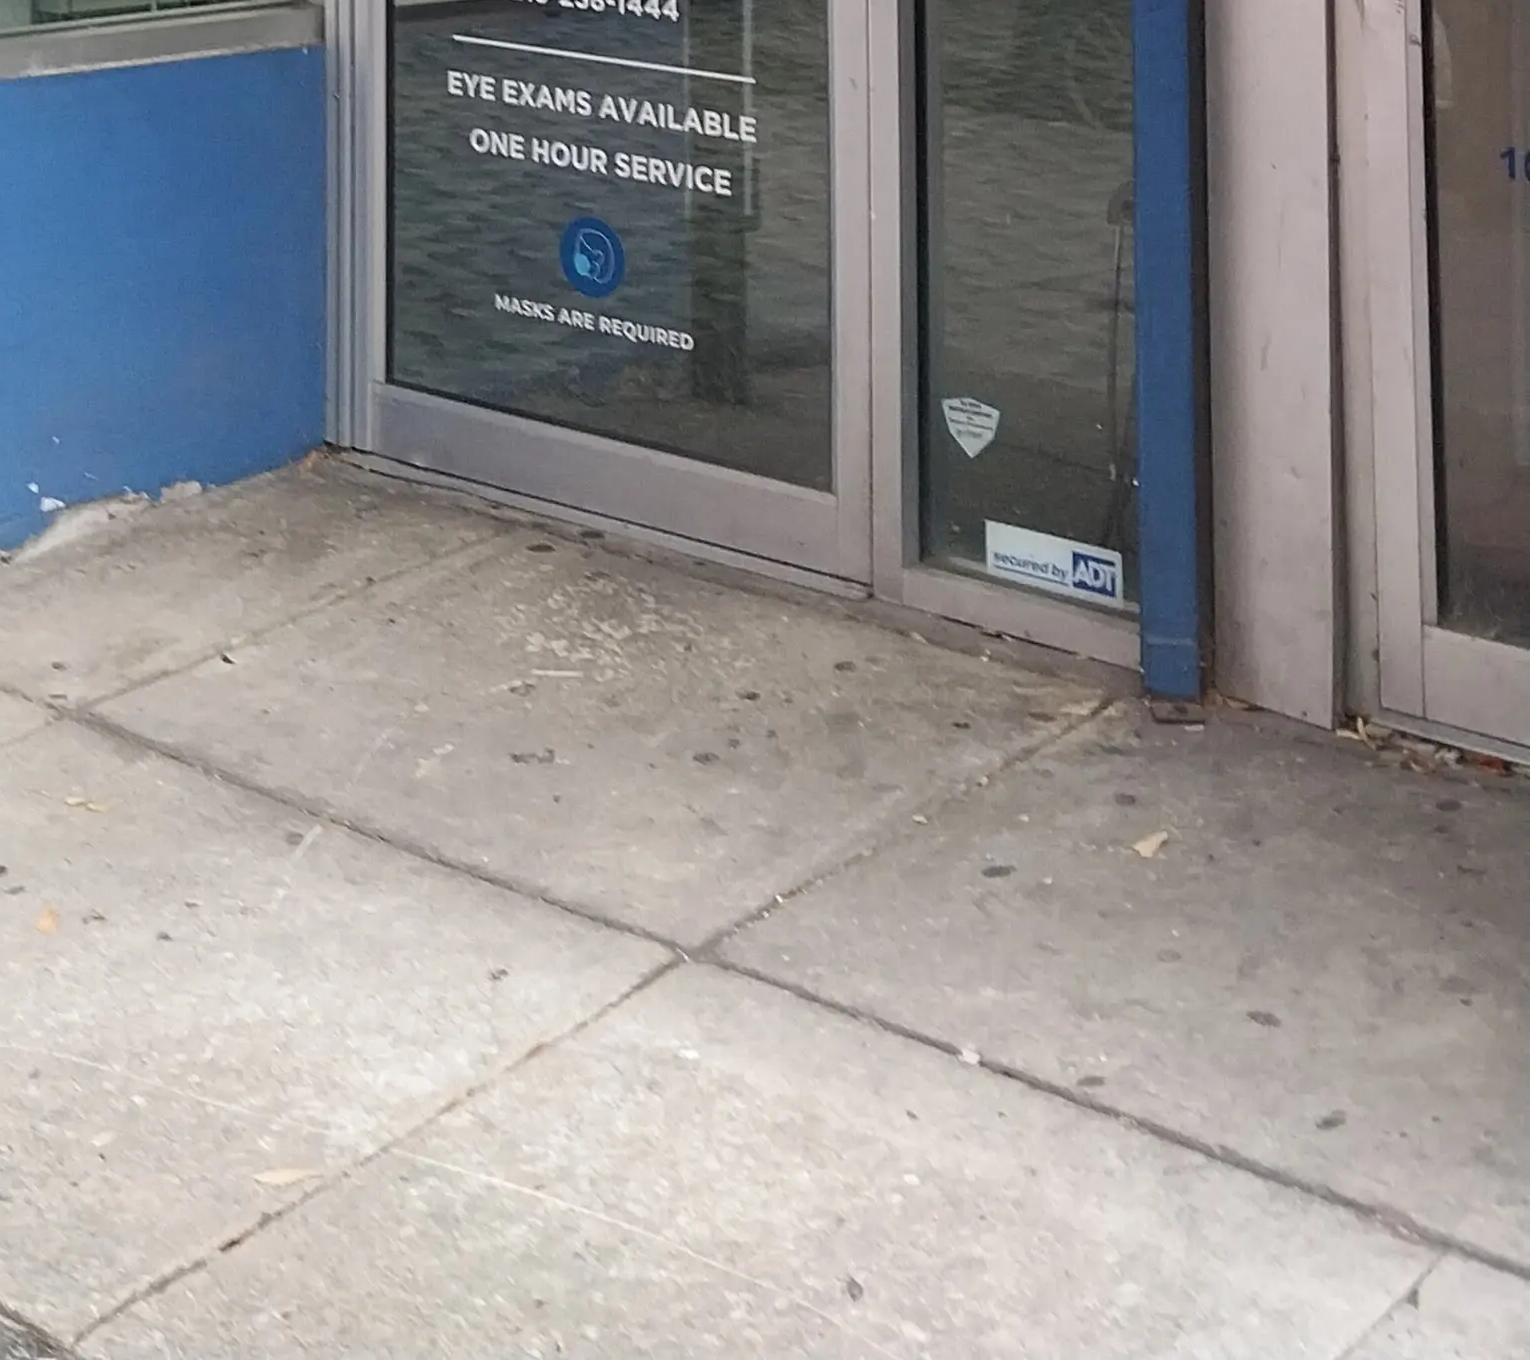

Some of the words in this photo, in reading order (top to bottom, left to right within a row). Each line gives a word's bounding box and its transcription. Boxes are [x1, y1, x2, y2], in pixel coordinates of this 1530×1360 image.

[447, 70, 496, 103] EYE
[502, 79, 592, 117] EXAMS
[598, 93, 757, 144] AVAILABLE
[470, 127, 525, 160] ONE
[531, 137, 608, 176] HOUR
[614, 152, 732, 197] SERVICE
[494, 294, 555, 323] MASKS
[558, 308, 595, 332] ARE
[599, 315, 695, 352] REQUIRED
[993, 552, 1049, 574] secured
[1052, 562, 1068, 580] by
[1074, 559, 1115, 591] ADT
